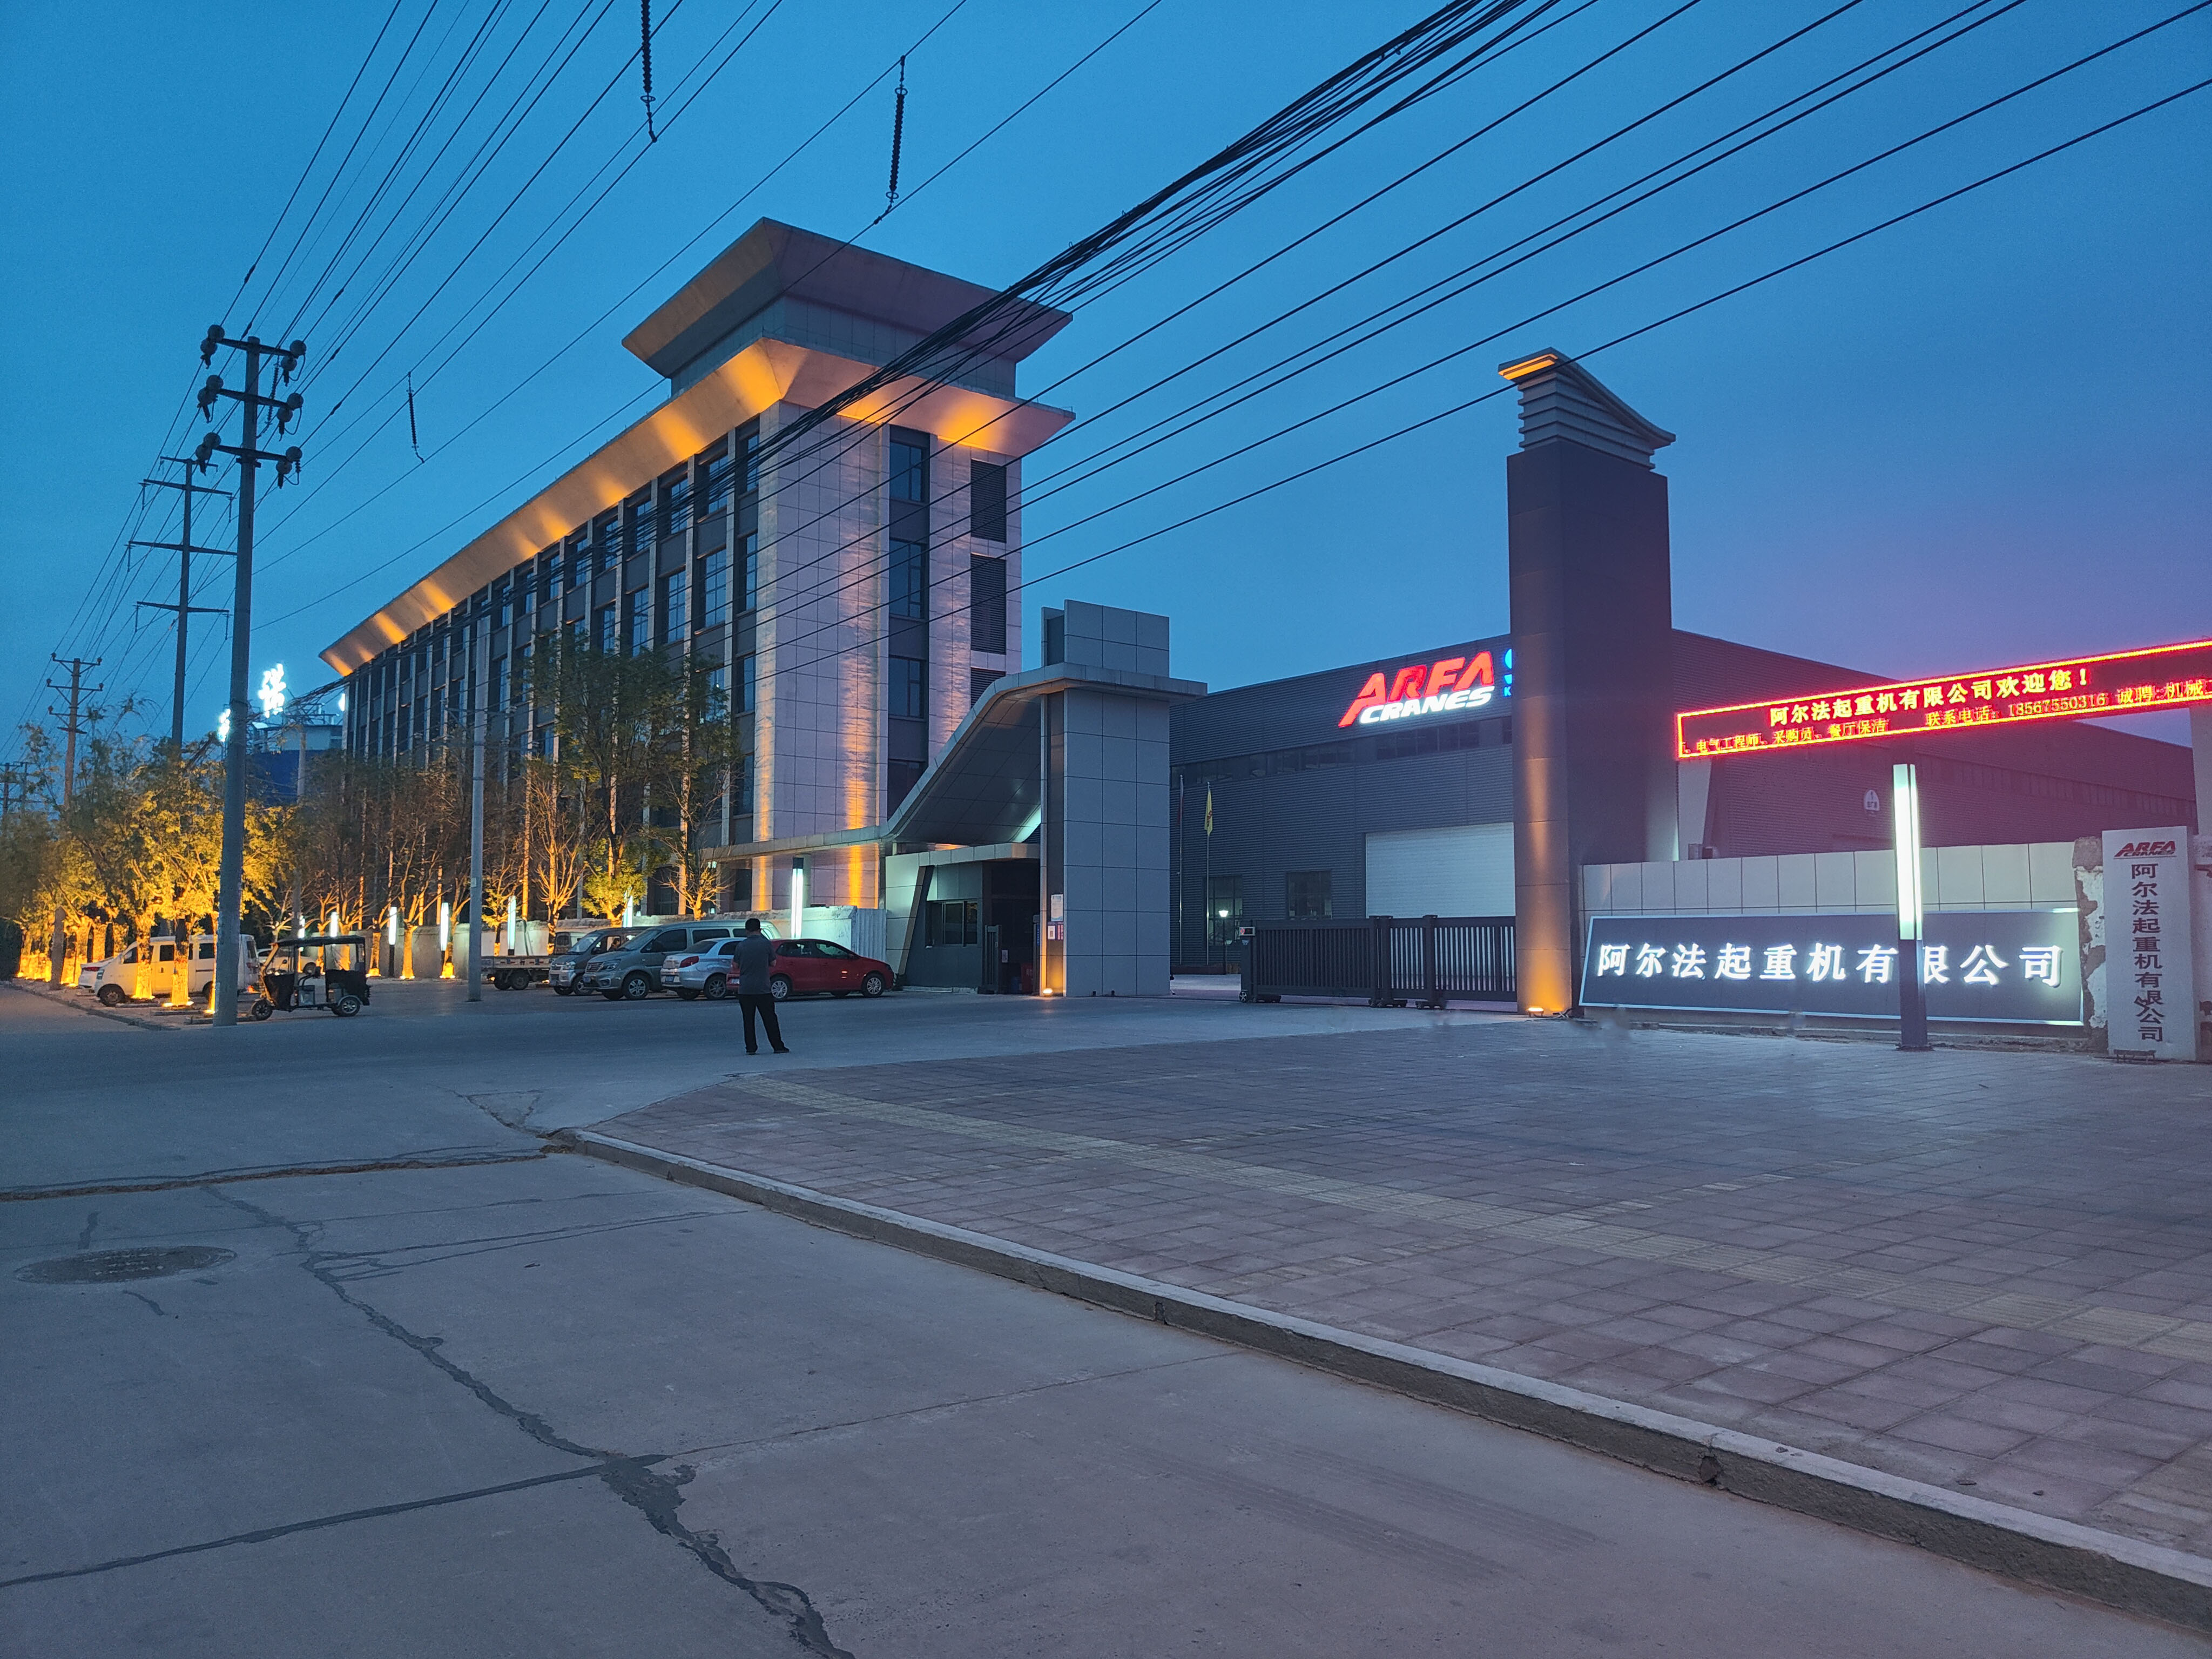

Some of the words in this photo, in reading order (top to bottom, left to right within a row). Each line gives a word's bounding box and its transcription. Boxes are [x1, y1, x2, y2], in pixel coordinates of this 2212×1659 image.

[1338, 651, 1494, 727] ARFA
[1359, 686, 1495, 724] CRANES
[1770, 668, 2088, 726] 阿尔法起重机有限公司欢迎您！
[2114, 840, 2175, 857] ARFA
